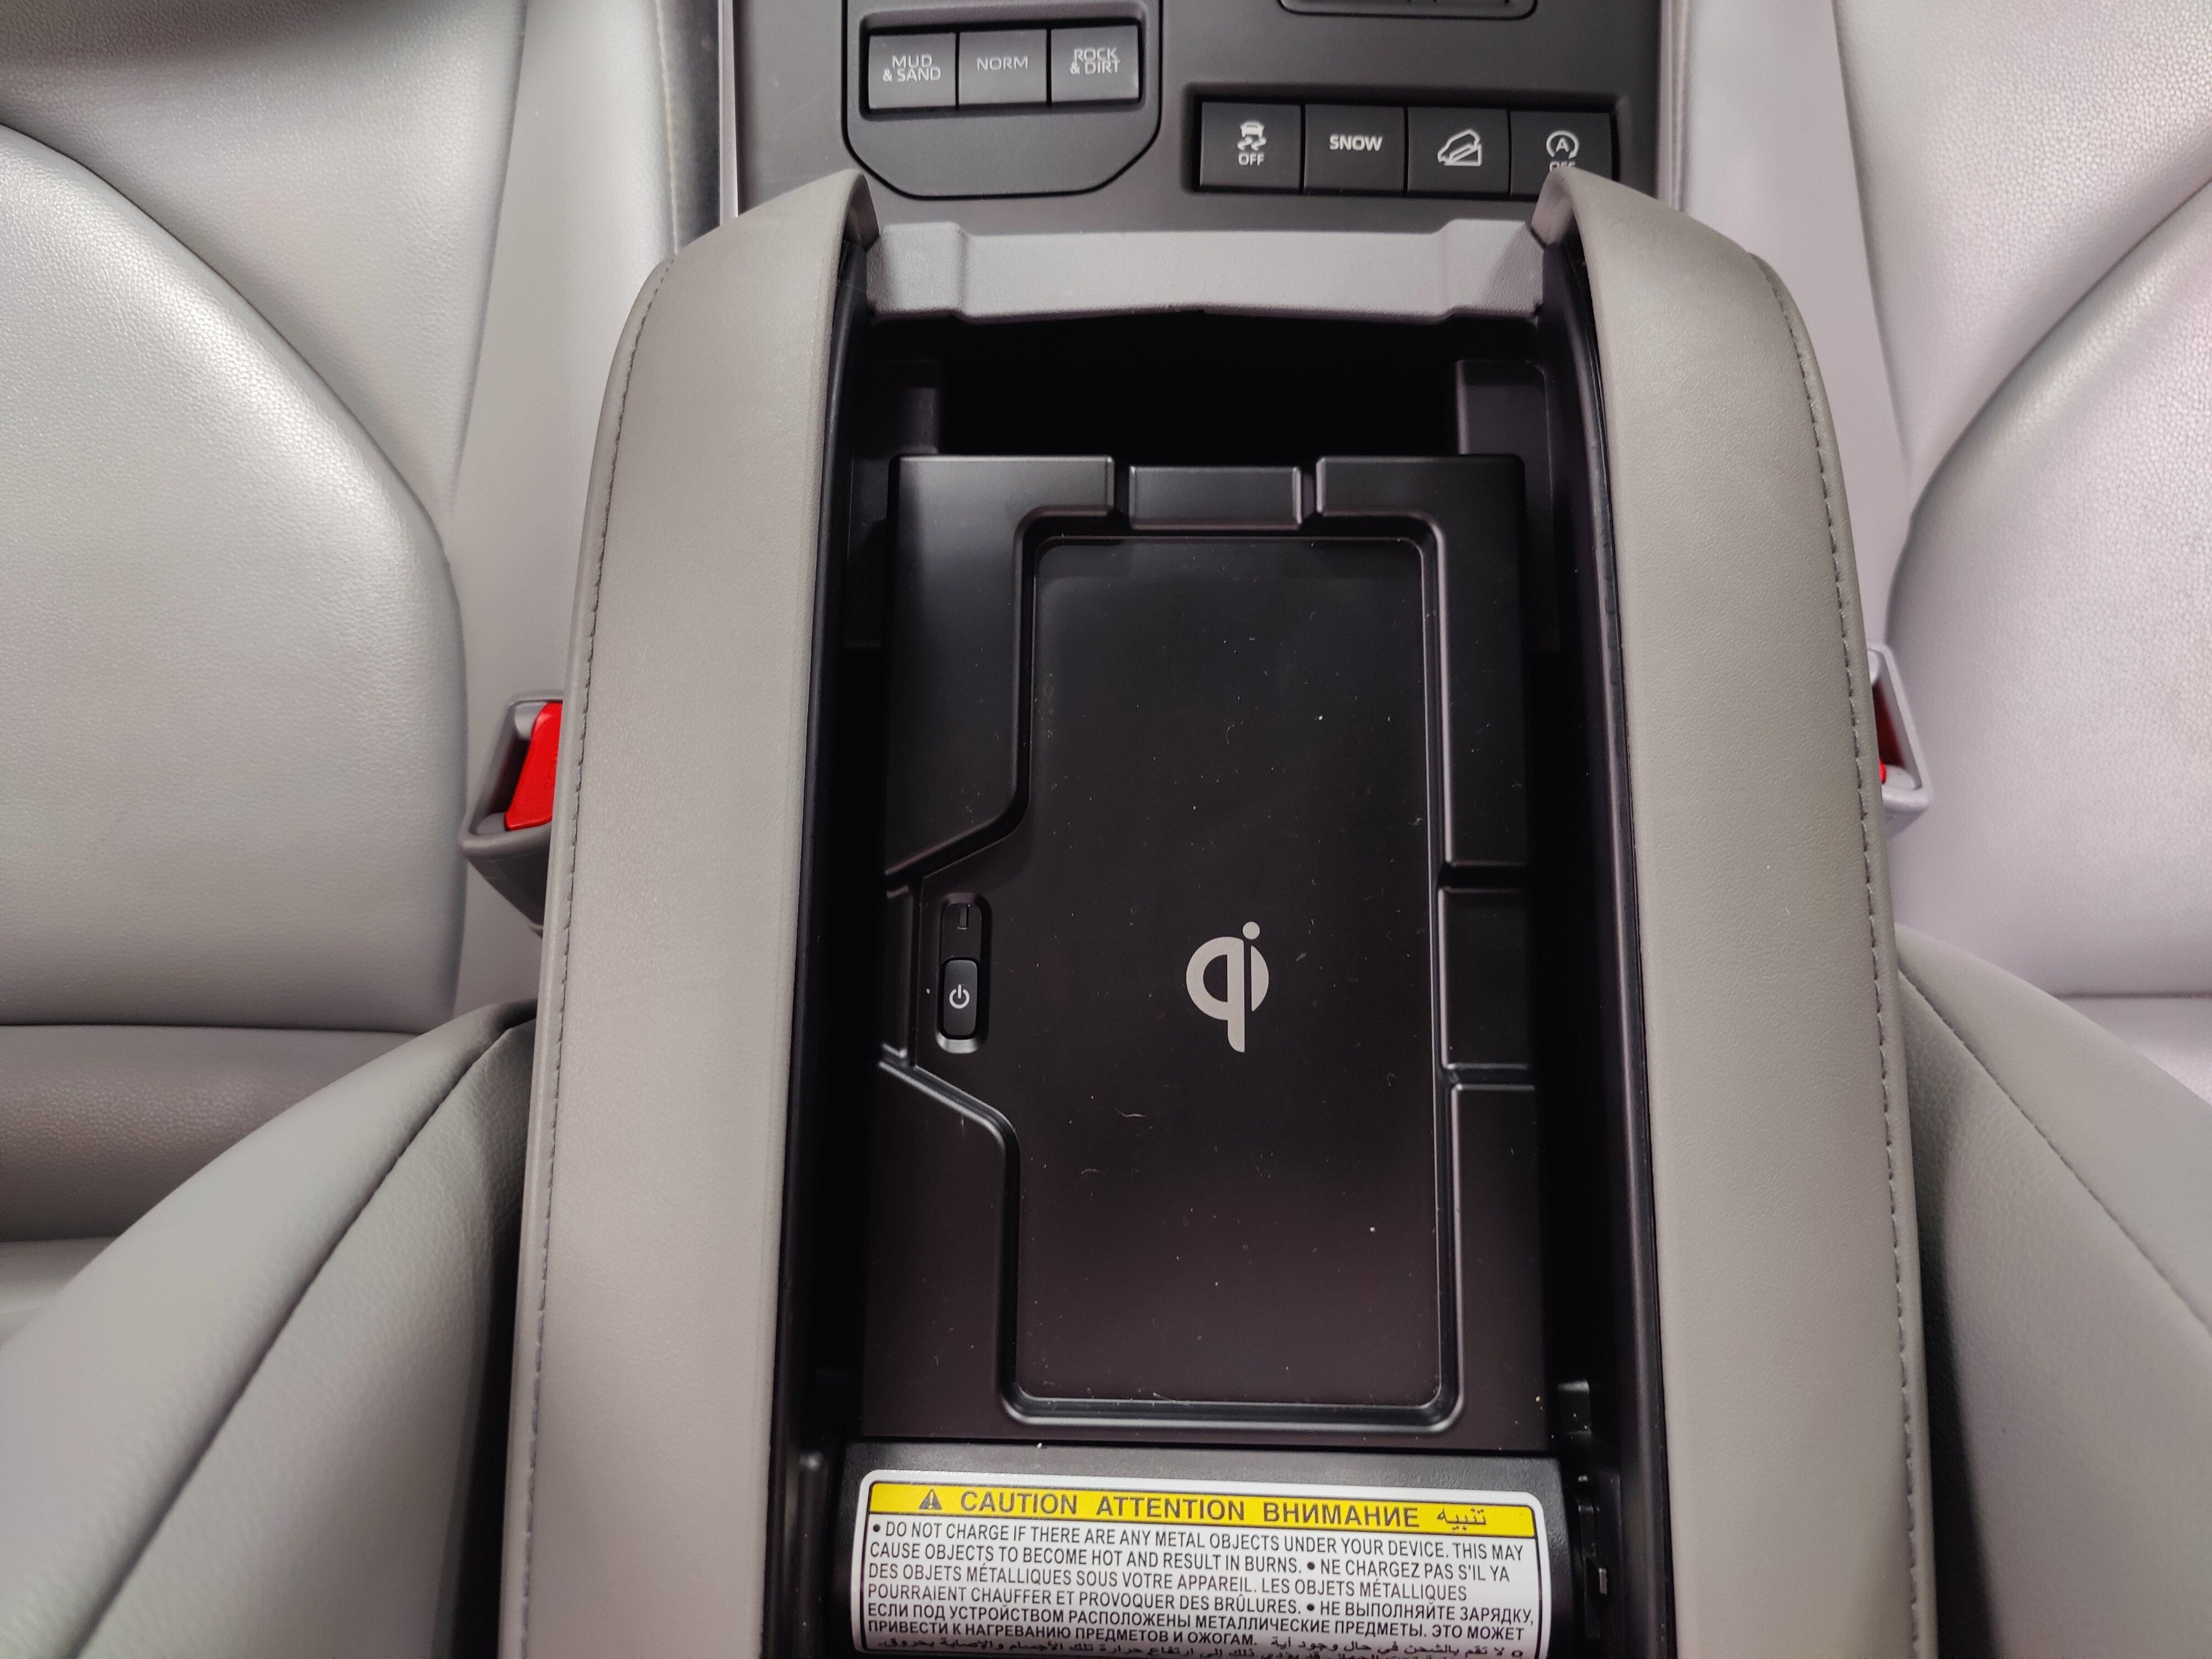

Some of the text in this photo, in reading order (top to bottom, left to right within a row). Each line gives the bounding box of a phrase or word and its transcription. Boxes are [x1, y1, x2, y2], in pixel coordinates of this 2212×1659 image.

[893, 55, 932, 69] MUD
[977, 56, 1028, 70] NORM
[1074, 48, 1118, 61] ROCK
[883, 66, 941, 82] & SAND
[1070, 60, 1120, 74] & DIRT
[1329, 134, 1383, 151] SNOW
[1238, 153, 1265, 166] OFF
[961, 1491, 1244, 1521] CAUTION ATTENTION
[1264, 1502, 1420, 1527] ВНИМАНИЕ
[1436, 1508, 1486, 1531] تنبيه
[886, 1521, 1523, 1561] DO NOT CHARGE IF THERE ARE ANY METAL OBJECTS UNDER YOUR DEVICE. THIS MAY
[870, 1542, 1301, 1573] CAUSE OBJECTS TO BECOME HOT AND RESULT IN BURNS.
[1321, 1559, 1340, 1575] NE
[1345, 1559, 1420, 1578] CHARGEZ
[1425, 1563, 1453, 1579] PAS
[1458, 1564, 1486, 1581] S'IL
[869, 1563, 1467, 1601] DES OBJETS MÉTALLIQUES SOUS VOTRE APPAREIL. LES OBJETS MÉTALLIQUES
[868, 1584, 1301, 1614] POURRAIENT CHAUFFER ET PROVOQUER DES BRÛLURES.
[868, 1603, 1524, 1641] ЕСЛИ ПОД УСТРОЙСТВОМ РАСПОЛОЖЕНЫ МЕТАЛЛИЧЕСКИЕ ПРЕДМЕТЫ. ЭТО МОЖЕТ
[1321, 1601, 1533, 1626] НЕ ВЫПОЛНЯЙТЕ ЗАРЯДКУ,
[869, 1620, 1257, 1646] ПРИВЕСТИ К НАГРЕВАНИЮ ПРЕДМЕТОВ И ОЖОГАМ.
[1344, 1640, 1371, 1652] حال
[1377, 1641, 1399, 1655] في
[1494, 1647, 1504, 1656] لا
